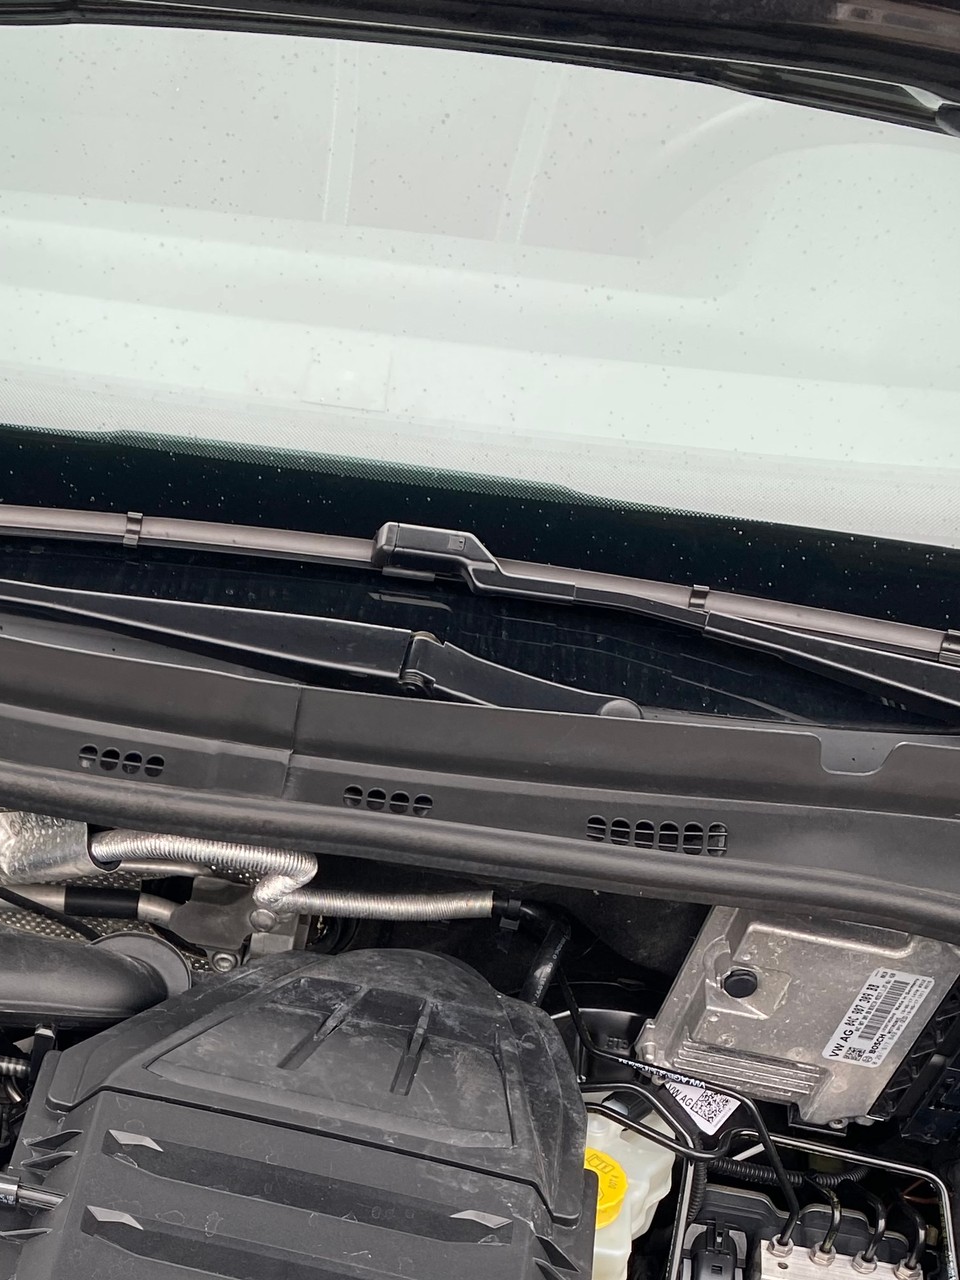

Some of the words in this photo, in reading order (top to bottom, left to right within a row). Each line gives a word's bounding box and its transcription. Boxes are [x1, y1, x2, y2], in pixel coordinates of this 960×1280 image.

[829, 1042, 845, 1058] VW
[838, 1028, 854, 1042] AG
[868, 1033, 886, 1054] BOSCH
[665, 1082, 682, 1099] VW
[679, 1093, 694, 1108] AG
